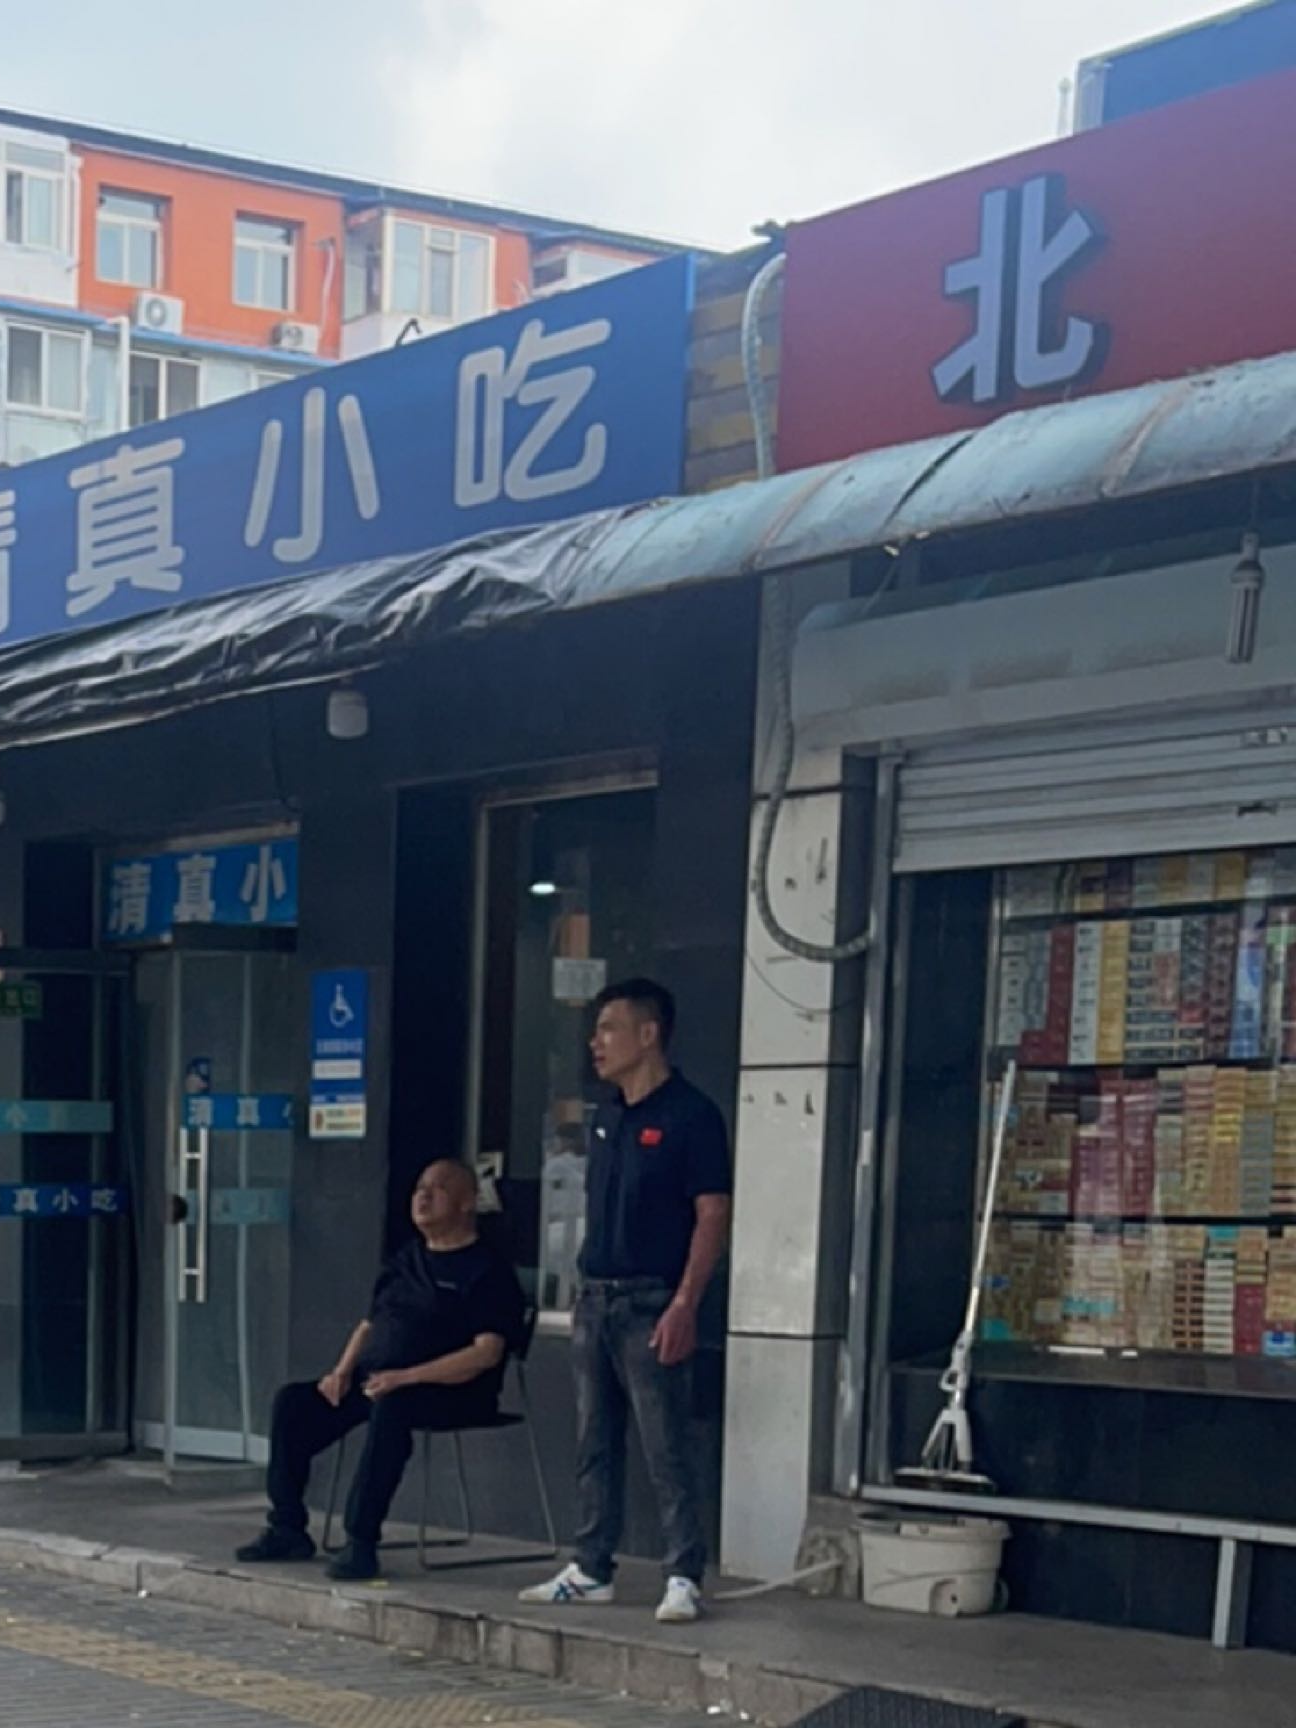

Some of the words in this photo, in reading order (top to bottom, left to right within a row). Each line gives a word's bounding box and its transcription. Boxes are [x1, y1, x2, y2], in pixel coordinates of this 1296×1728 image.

[931, 175, 1094, 403] 北
[108, 844, 288, 935] 清真小
